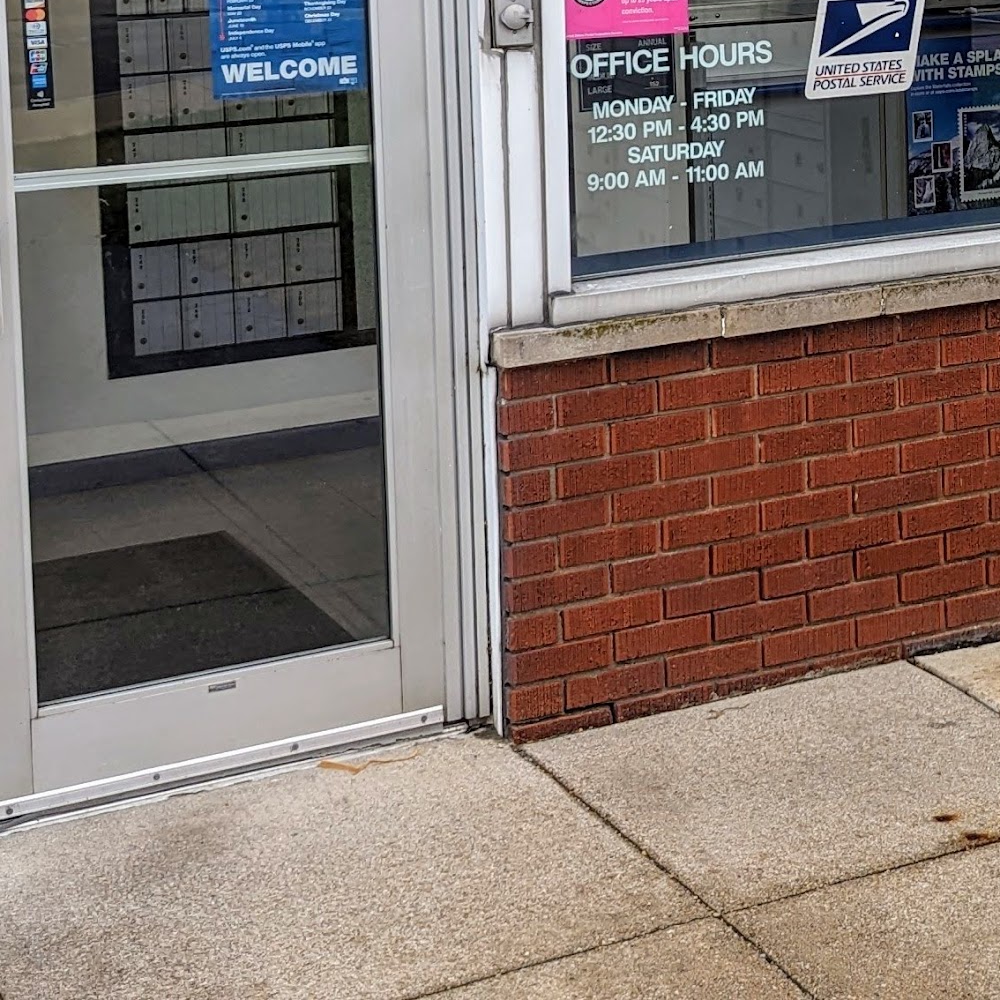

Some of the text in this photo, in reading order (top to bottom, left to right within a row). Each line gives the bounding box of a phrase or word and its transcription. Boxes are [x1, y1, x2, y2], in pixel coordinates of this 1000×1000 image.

[622, 7, 654, 15] conviction.
[274, 42, 291, 50] USPS
[585, 38, 667, 51] SIZE ANNUAL
[230, 52, 250, 60] always
[250, 51, 267, 59] open.
[570, 40, 773, 79] OFFICE HOURS
[953, 52, 963, 65] A
[221, 55, 358, 84] WELCOME
[815, 59, 902, 77] UNITED STATES
[587, 85, 612, 95] LARGE
[813, 73, 906, 91] POSTAL SERVICE
[592, 95, 674, 119] MONDAY
[693, 87, 757, 109] FRIDAY
[587, 123, 636, 143] 12:30
[643, 119, 672, 138] PM
[690, 113, 730, 133] 4:30
[736, 109, 764, 128] PM
[627, 140, 725, 164] SATURDAY
[587, 171, 629, 192] 9:00
[635, 168, 666, 188] AM
[686, 164, 729, 183] 11:00
[734, 160, 764, 179] AM
